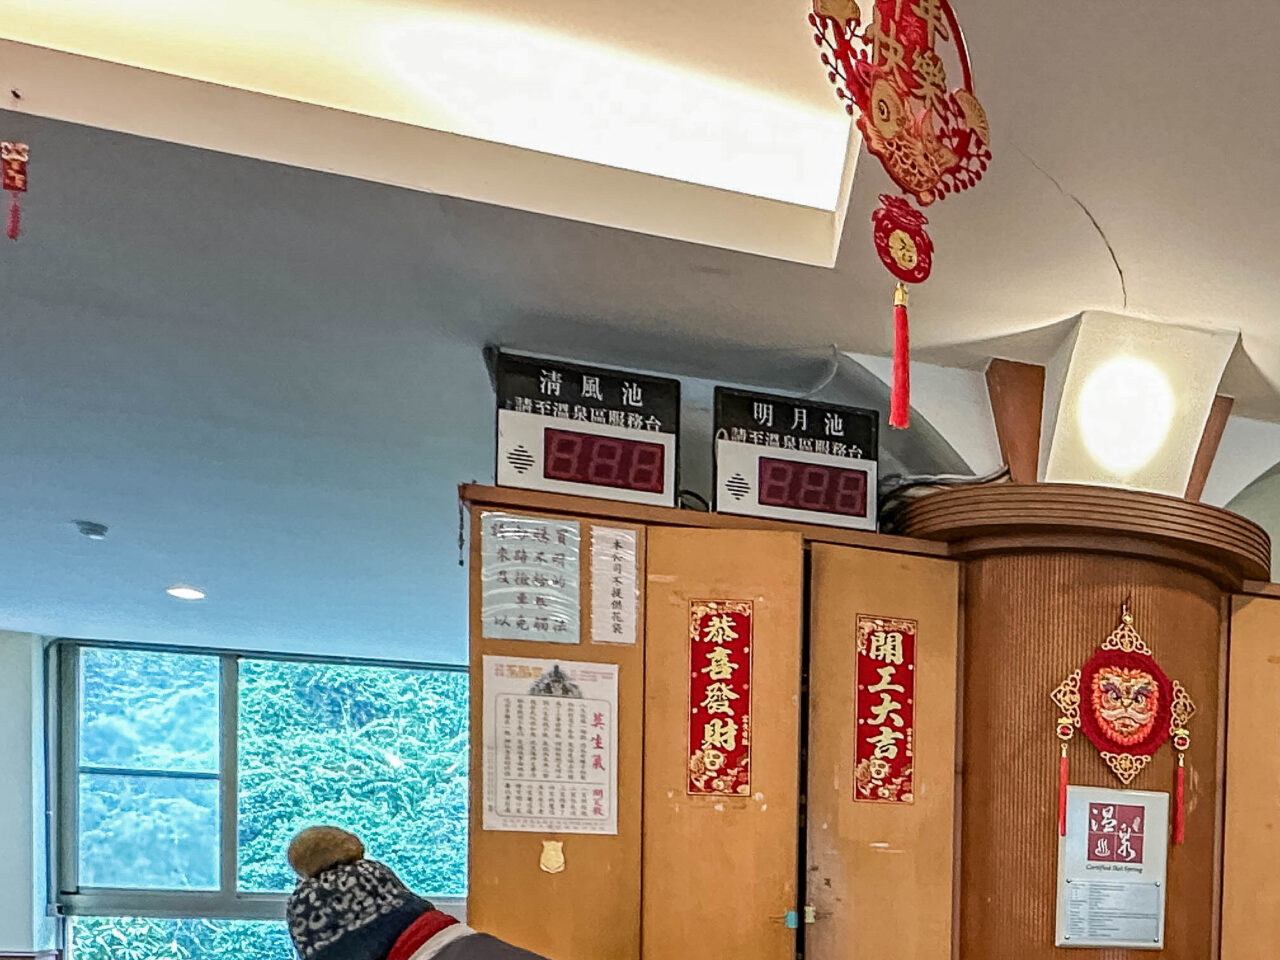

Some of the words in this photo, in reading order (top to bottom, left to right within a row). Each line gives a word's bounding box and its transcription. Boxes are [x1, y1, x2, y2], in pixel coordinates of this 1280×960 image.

[539, 369, 643, 407] 清風池
[753, 402, 844, 437] 明月池
[700, 615, 740, 750] 恭喜發財
[866, 631, 905, 760] 開工大吉
